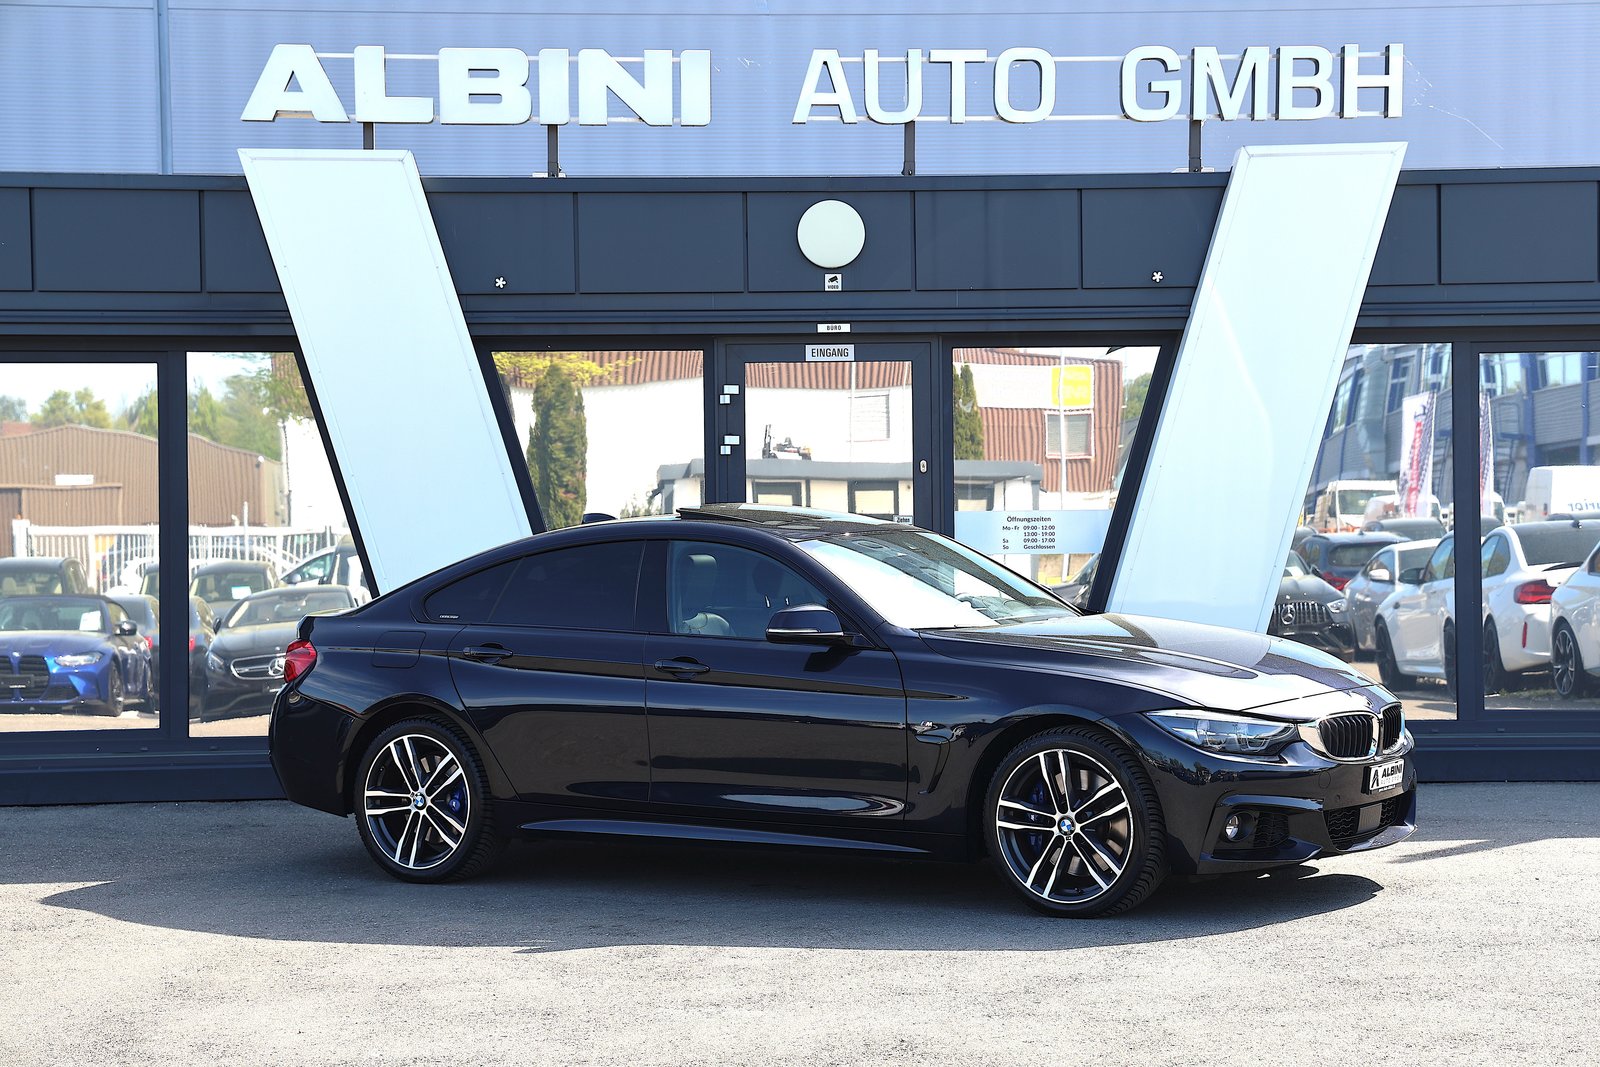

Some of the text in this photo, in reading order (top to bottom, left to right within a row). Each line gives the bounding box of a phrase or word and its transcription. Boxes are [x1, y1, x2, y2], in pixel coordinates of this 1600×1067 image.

[240, 43, 1404, 127] ALBINI AUTO GMBH
[811, 347, 849, 358] EINGANG
[1006, 515, 1052, 523] Öffnungszeiten
[1381, 763, 1403, 778] ALBINI
